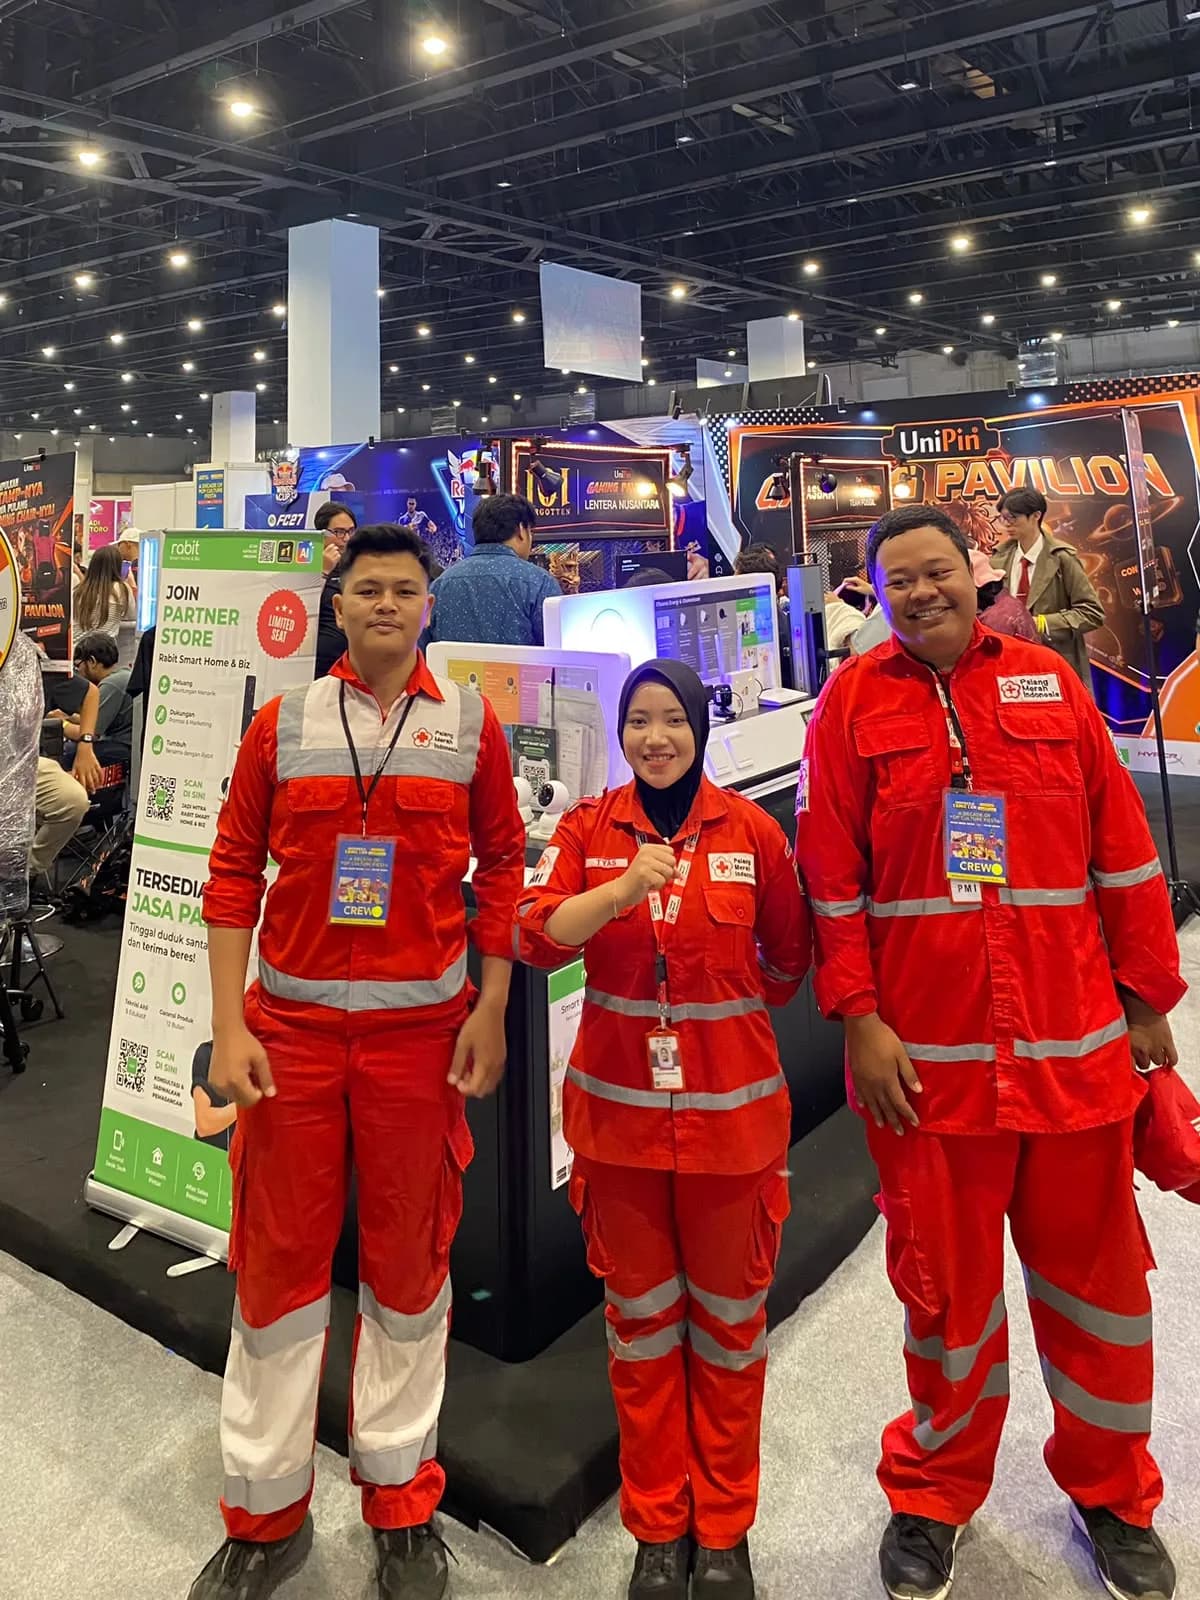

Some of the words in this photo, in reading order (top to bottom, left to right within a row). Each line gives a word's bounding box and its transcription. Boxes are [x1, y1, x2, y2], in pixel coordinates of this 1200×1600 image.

[900, 426, 980, 454] UniPin
[936, 453, 1175, 498] PAVILION
[584, 500, 618, 510] LENTERA
[619, 499, 660, 510] NUSANTARA
[276, 514, 304, 526] FC27
[171, 540, 200, 555] rabit
[300, 548, 310, 558] AI
[166, 586, 200, 600] JOIN
[24, 604, 64, 618] PAVILION
[163, 606, 240, 626] PARTNER
[268, 614, 296, 632] LIMITED
[161, 628, 213, 648] STORE
[271, 630, 288, 644] SEAT
[159, 654, 178, 664] Rabit
[179, 655, 202, 666] Smart
[204, 657, 229, 668] Home
[230, 659, 236, 668] &
[238, 659, 251, 669] Biz
[1020, 678, 1048, 686] Palang
[184, 779, 203, 788] SCAN
[960, 861, 992, 872] CREW
[958, 884, 977, 892] PMI
[132, 892, 173, 920] JASA
[344, 906, 373, 916] CREW
[129, 922, 156, 938] Tinggal
[158, 930, 184, 944] duduk
[128, 938, 141, 948] dan
[142, 942, 168, 956] terima
[170, 948, 196, 963] beres!
[561, 1000, 580, 1014] Smart
[156, 1050, 175, 1062] SCAN
[156, 1061, 164, 1069] DI
